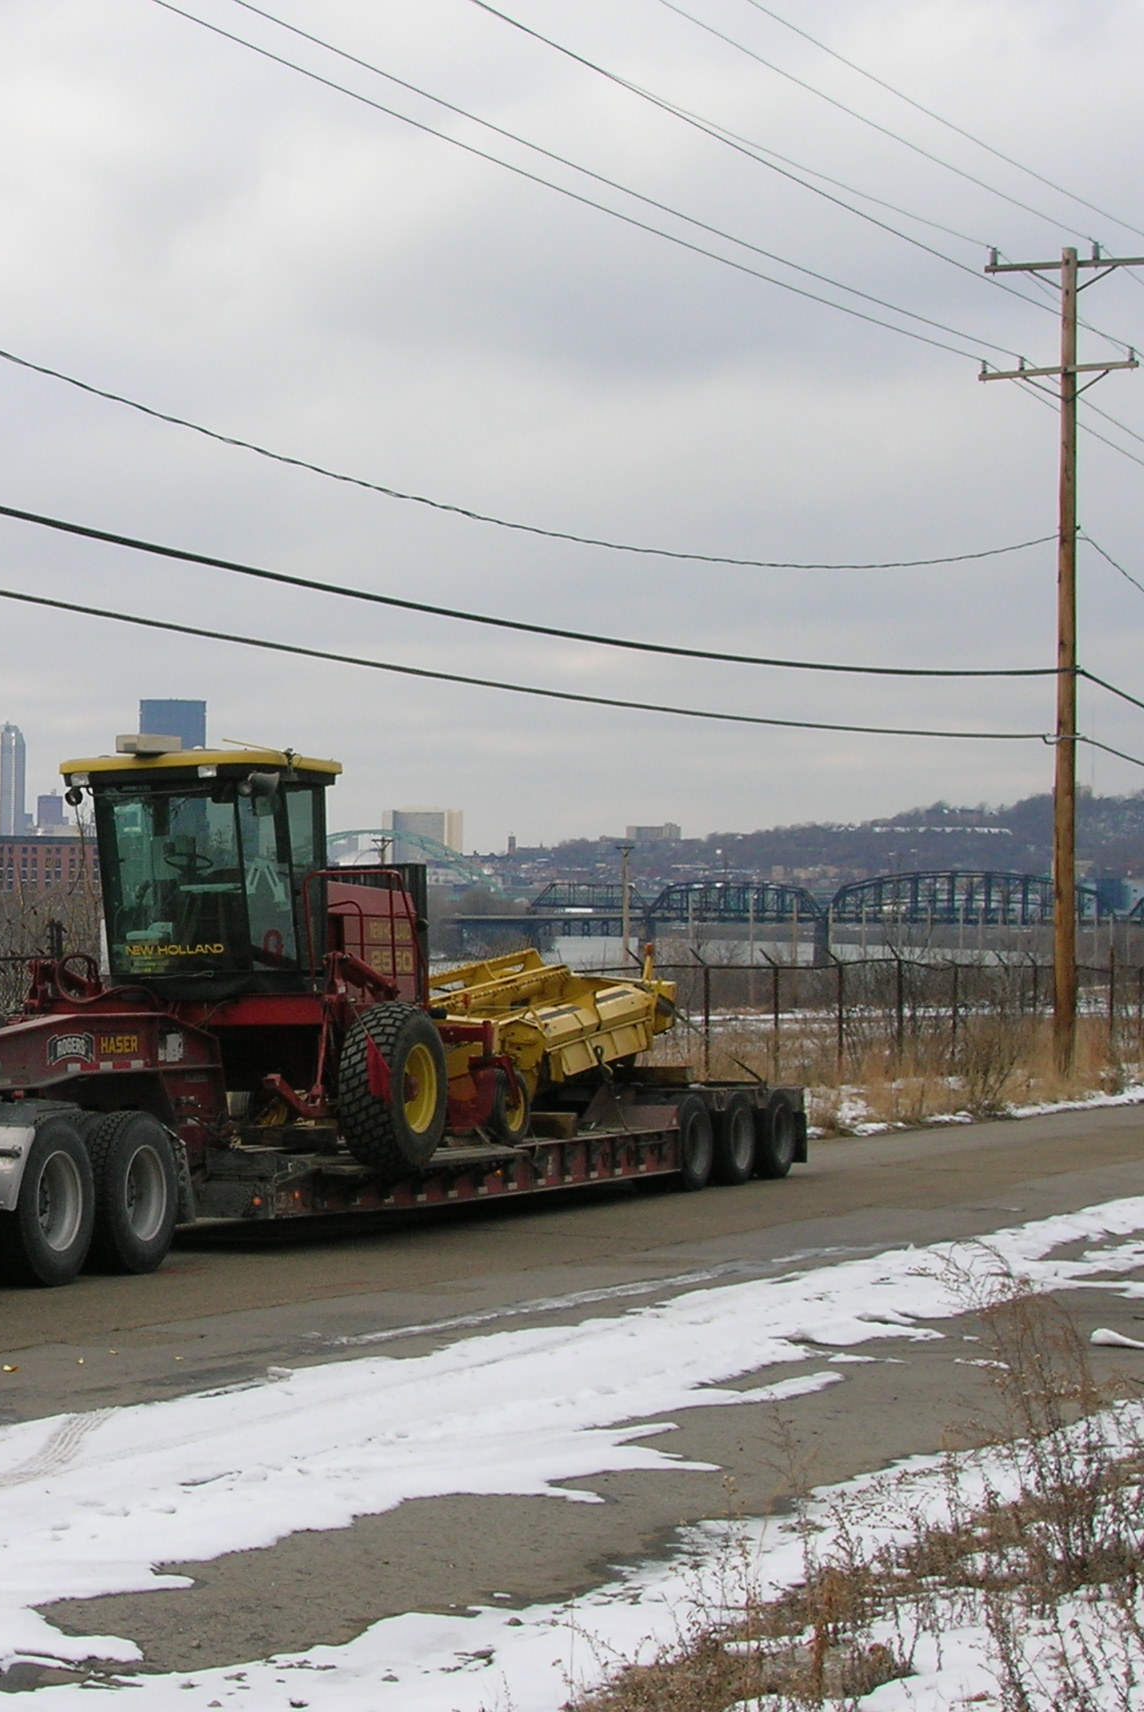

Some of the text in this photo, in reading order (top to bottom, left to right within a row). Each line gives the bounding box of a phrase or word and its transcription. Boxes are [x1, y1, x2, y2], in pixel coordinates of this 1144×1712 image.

[124, 943, 225, 956] NEW HOLLAND
[100, 1035, 138, 1054] HASER
